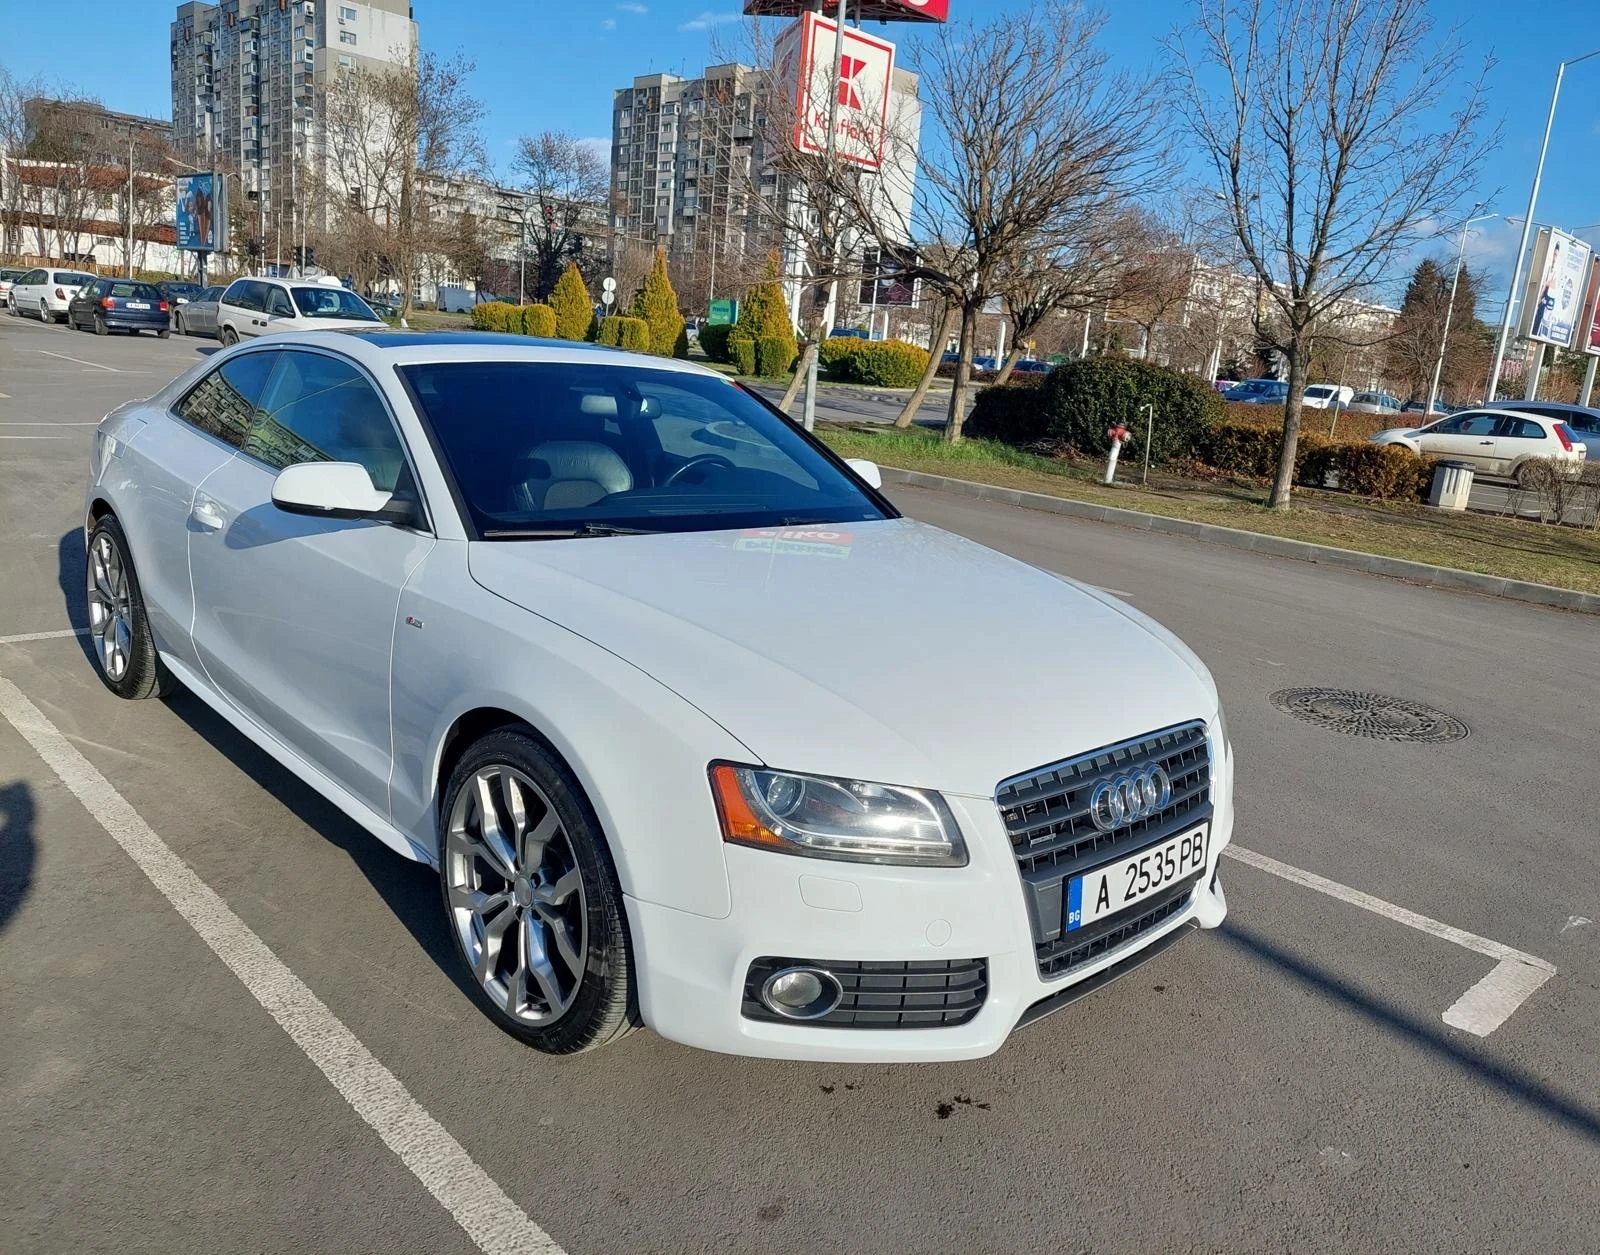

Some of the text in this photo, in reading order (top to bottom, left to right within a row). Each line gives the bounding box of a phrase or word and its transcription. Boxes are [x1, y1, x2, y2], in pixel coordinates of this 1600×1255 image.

[1095, 831, 1203, 914] A 2535 PB
[1068, 909, 1081, 925] BG
